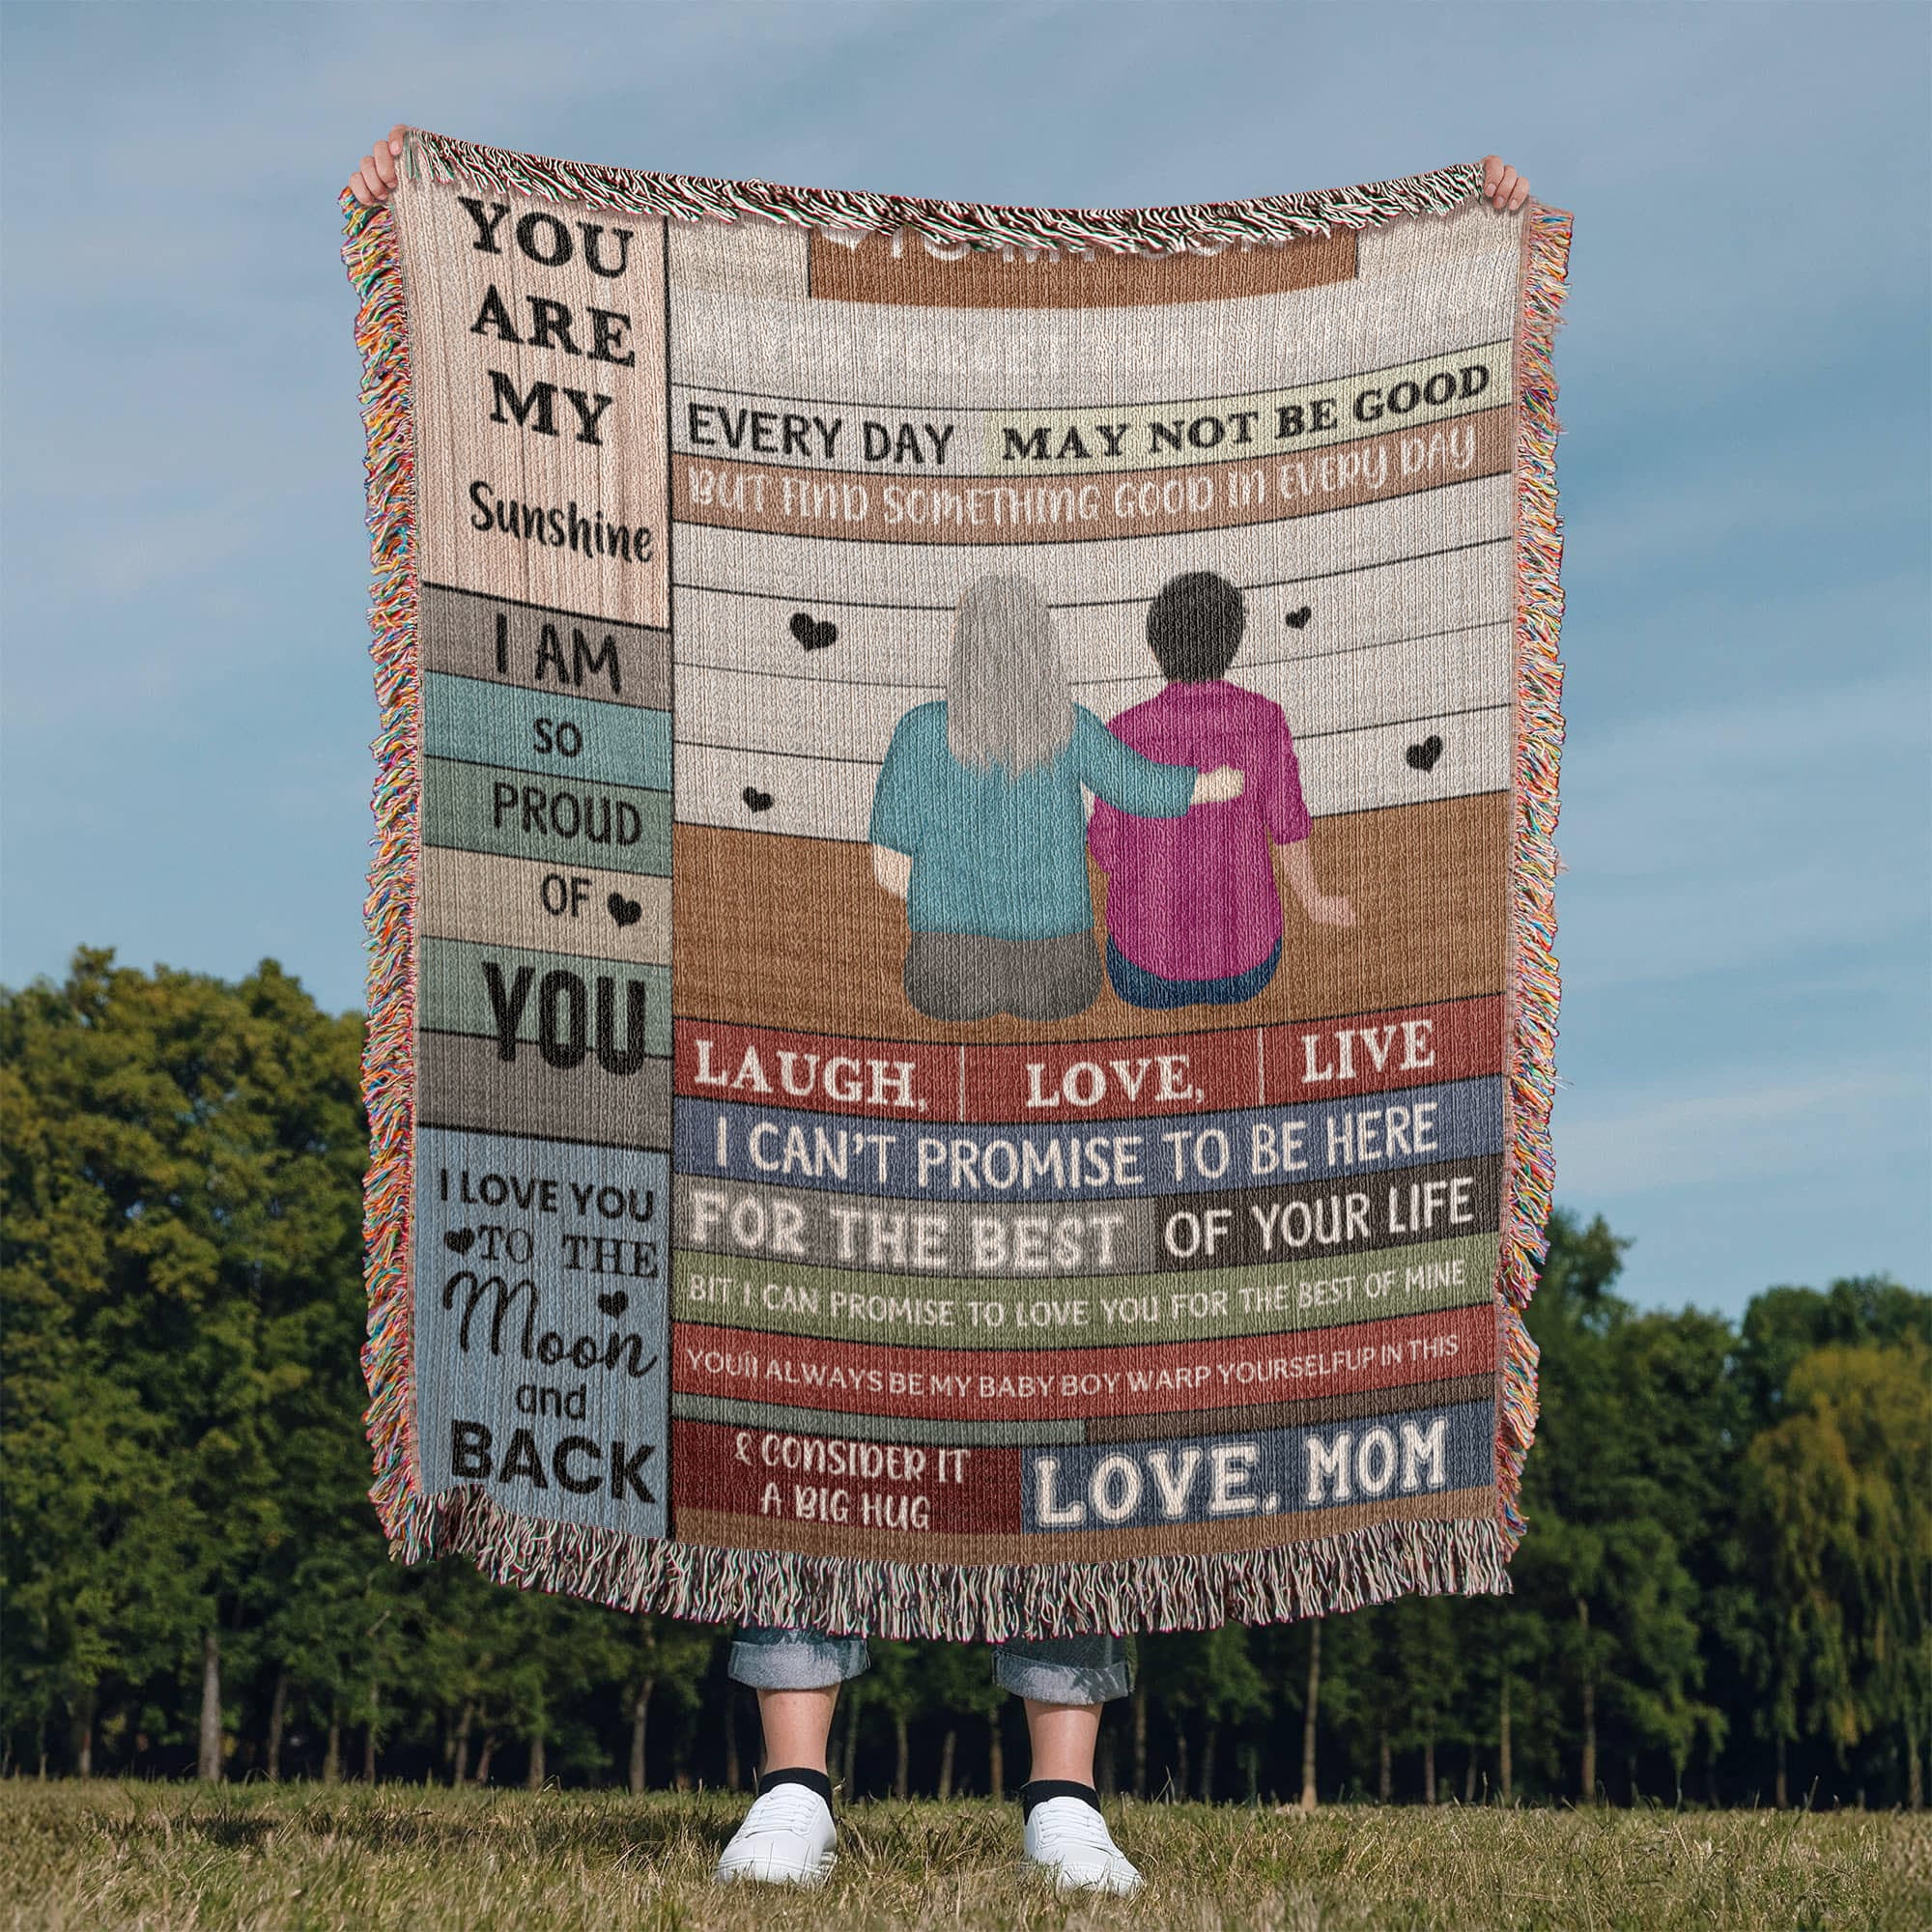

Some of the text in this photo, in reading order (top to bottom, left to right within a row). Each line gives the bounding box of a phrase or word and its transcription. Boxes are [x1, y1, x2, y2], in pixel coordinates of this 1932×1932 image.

[458, 196, 635, 279] YOU
[470, 284, 636, 367] ARE
[488, 370, 612, 446] MY
[689, 364, 1490, 465] EVERY DAY MAY NOT BE GOOD
[688, 466, 770, 514] BUT
[883, 486, 1101, 528] SOMETHING
[1115, 476, 1214, 520] GOOD
[1280, 445, 1388, 500] EVERY
[1401, 424, 1475, 476] DAY
[469, 481, 654, 562] Sunshine
[496, 613, 623, 695] I AM
[532, 717, 582, 758] SO
[493, 781, 642, 846] PROUD
[540, 872, 592, 918] OF
[483, 960, 647, 1077] YOU
[694, 1018, 1436, 1112] LAUGH, LOVE, LIVE
[717, 1117, 727, 1167] I
[919, 1138, 1144, 1189] PROMISE
[1163, 1128, 1229, 1182] TO
[1251, 1121, 1308, 1176] BE
[1328, 1101, 1439, 1168] HERE
[440, 1169, 654, 1223] I LOVE YOU
[689, 1177, 1474, 1269] FOR THE BEST OF YOUR LIFE
[478, 1224, 660, 1279] TO THE
[442, 1270, 658, 1378] Moon
[742, 1281, 752, 1305] I
[763, 1284, 818, 1315] CAN
[830, 1291, 955, 1327] PROMISE
[965, 1301, 1005, 1328] TO
[1016, 1301, 1089, 1326] LOVE
[1101, 1297, 1157, 1325] YOU
[1170, 1290, 1228, 1321] FOR
[1238, 1285, 1290, 1314] THE
[1298, 1276, 1355, 1308] BEST
[1365, 1269, 1394, 1299] OF
[1405, 1260, 1465, 1293] MINE
[515, 1383, 587, 1421] and
[765, 1354, 882, 1393] ALWAYS
[889, 1374, 924, 1395] BE
[930, 1375, 972, 1397] MY
[980, 1376, 1055, 1400] BABY
[1063, 1376, 1122, 1397] BOY
[1126, 1365, 1209, 1393] WARP
[1381, 1344, 1402, 1365] IN
[1407, 1334, 1459, 1359] THIS
[451, 1419, 656, 1504] BACK
[733, 1432, 971, 1485] & CONSIDER IT
[1303, 1415, 1447, 1507] MOM
[761, 1482, 931, 1531] A BIG HUG
